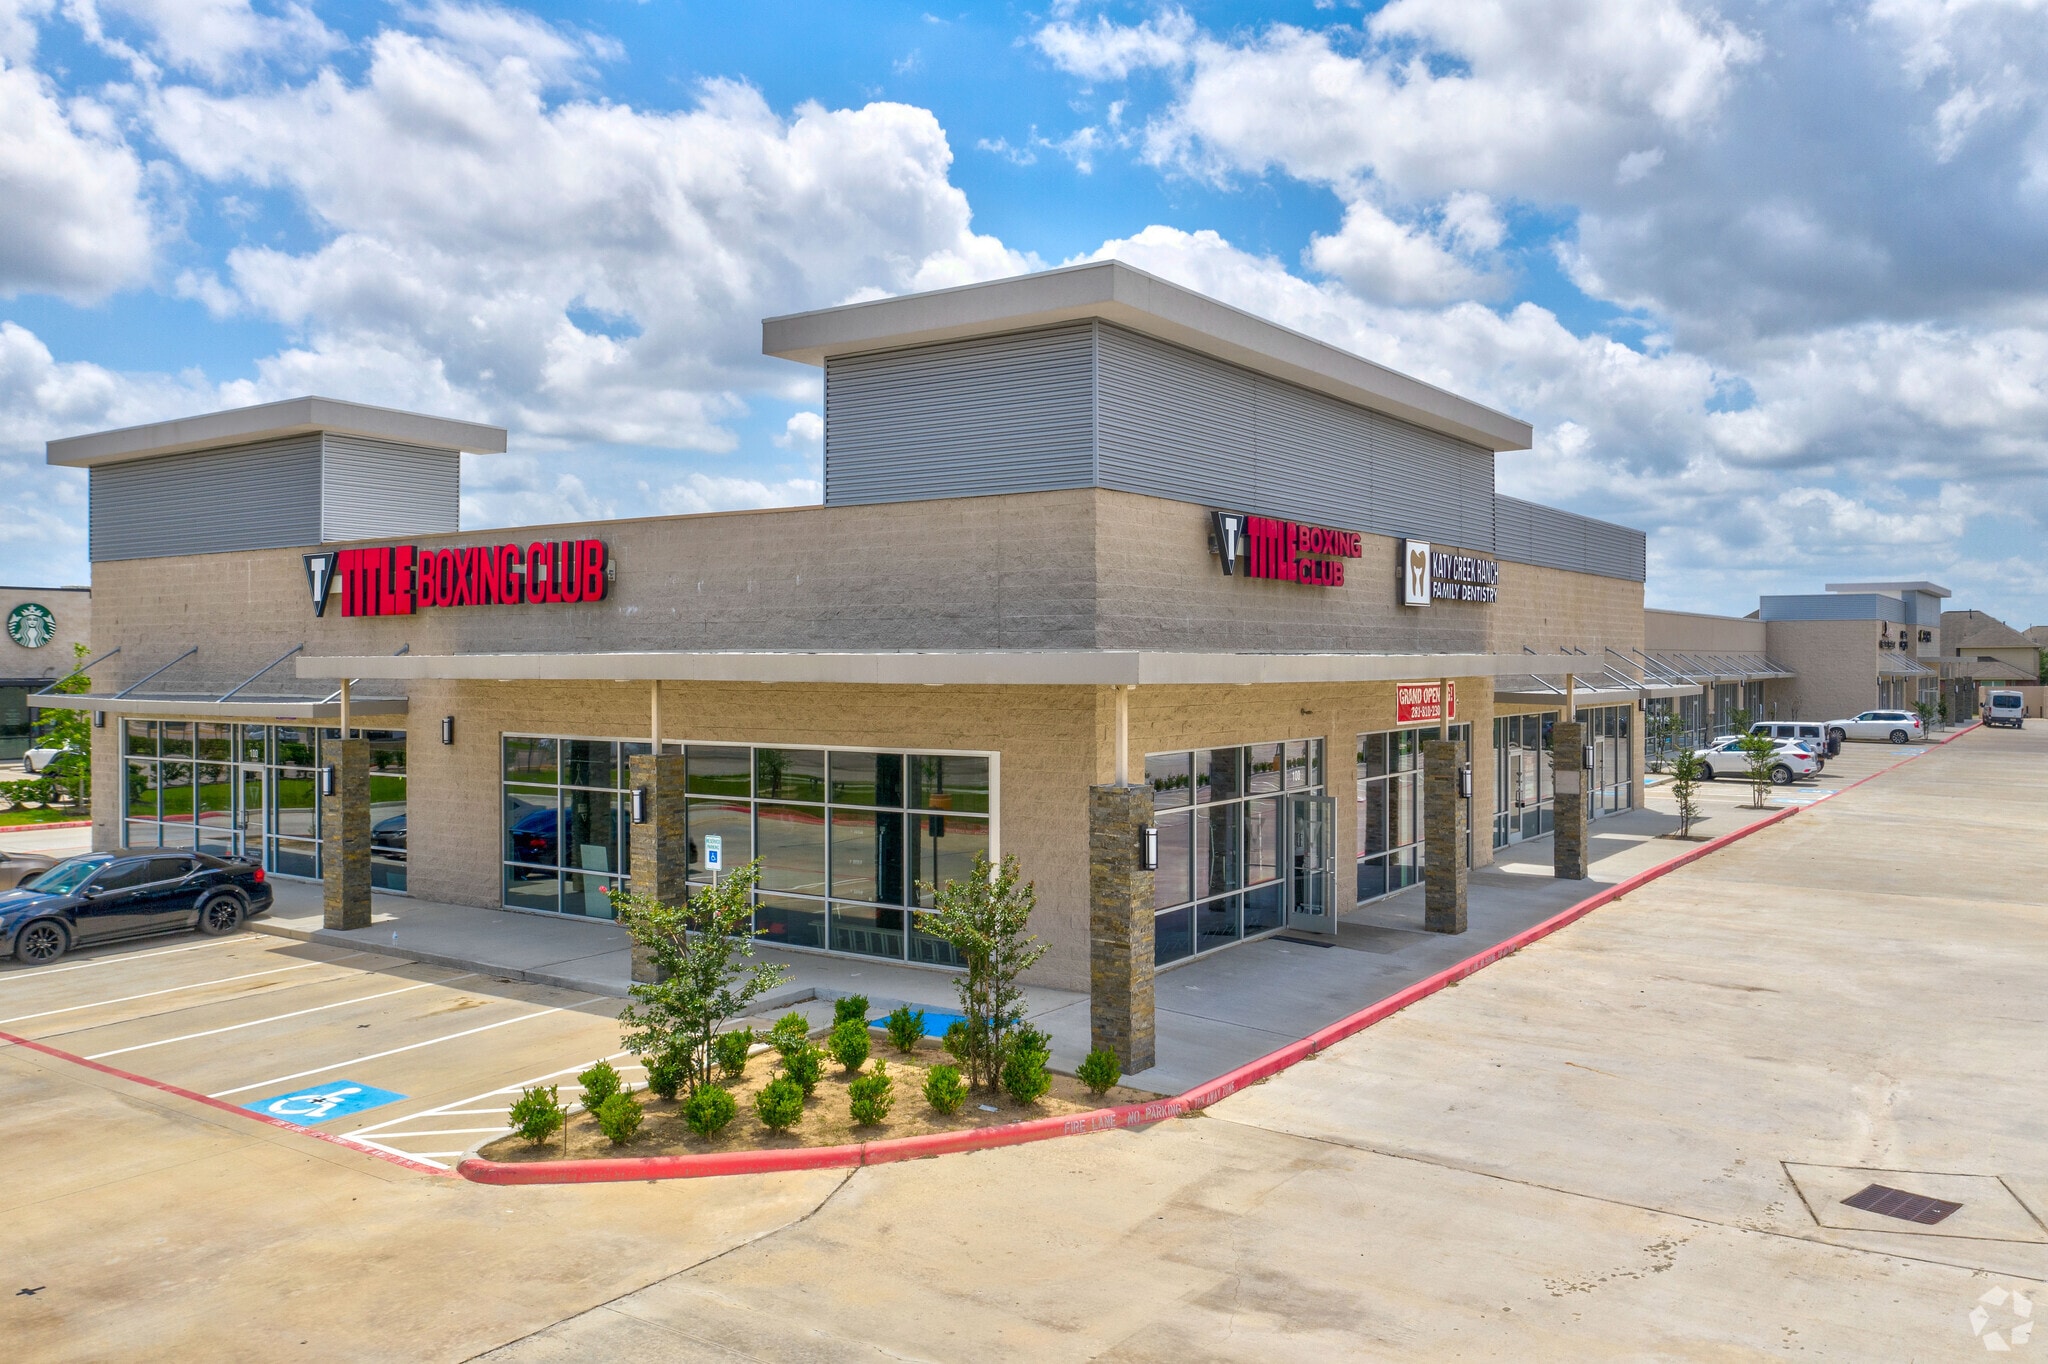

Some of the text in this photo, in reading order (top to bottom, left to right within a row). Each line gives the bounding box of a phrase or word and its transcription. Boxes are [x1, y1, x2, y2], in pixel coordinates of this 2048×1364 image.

[1247, 515, 1363, 582] TITLE BOXING
[338, 539, 608, 617] TITLE BOXING CLUB
[1300, 558, 1345, 587] CLUB
[1432, 552, 1499, 585] KATY CREEK RANCH
[1432, 581, 1498, 603] FAMILY DENTISTRY
[1399, 687, 1422, 705] GRAND
[1411, 704, 1441, 718] 281-810-230
[1064, 1119, 1086, 1135] FIRE
[1091, 1113, 1117, 1131] LANE
[1127, 1110, 1140, 1125] NO
[1145, 1103, 1182, 1120] PARKING
